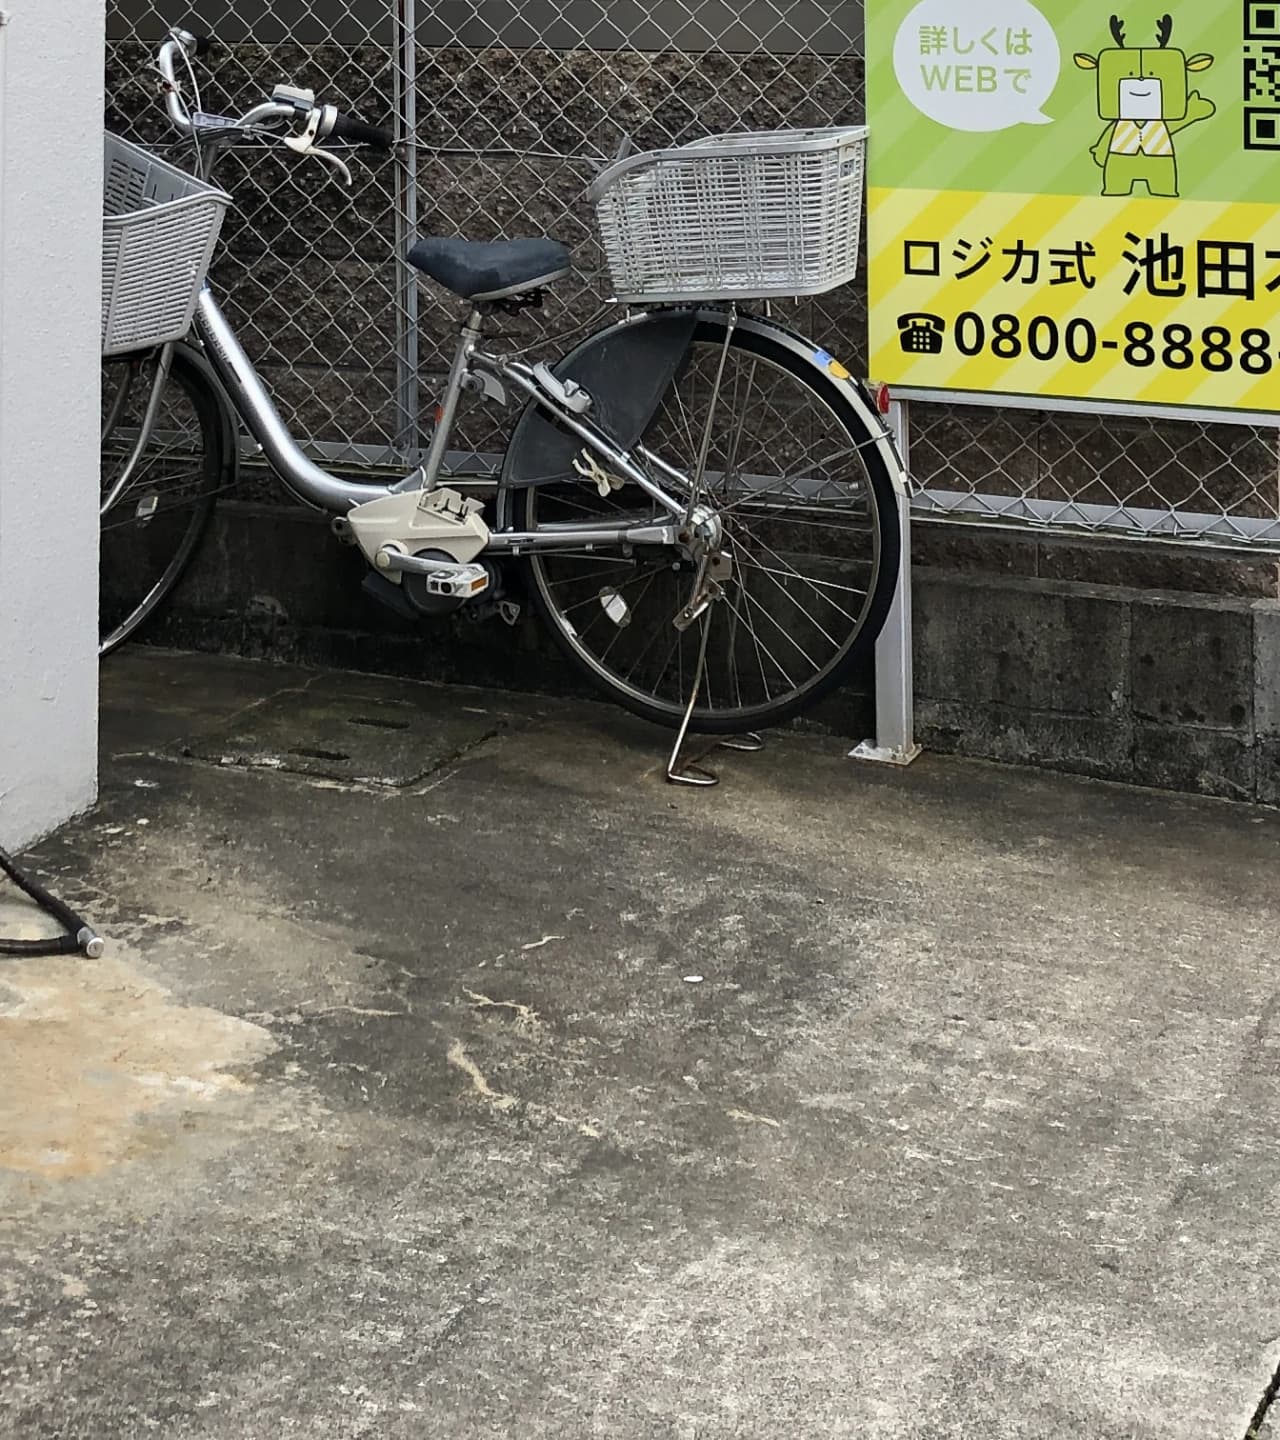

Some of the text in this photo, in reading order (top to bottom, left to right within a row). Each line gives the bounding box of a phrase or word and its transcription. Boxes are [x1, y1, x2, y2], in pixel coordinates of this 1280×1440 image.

[918, 25, 1033, 57] 詳しくは
[920, 64, 1032, 95] WEBで
[903, 236, 1097, 290] ロジカ式
